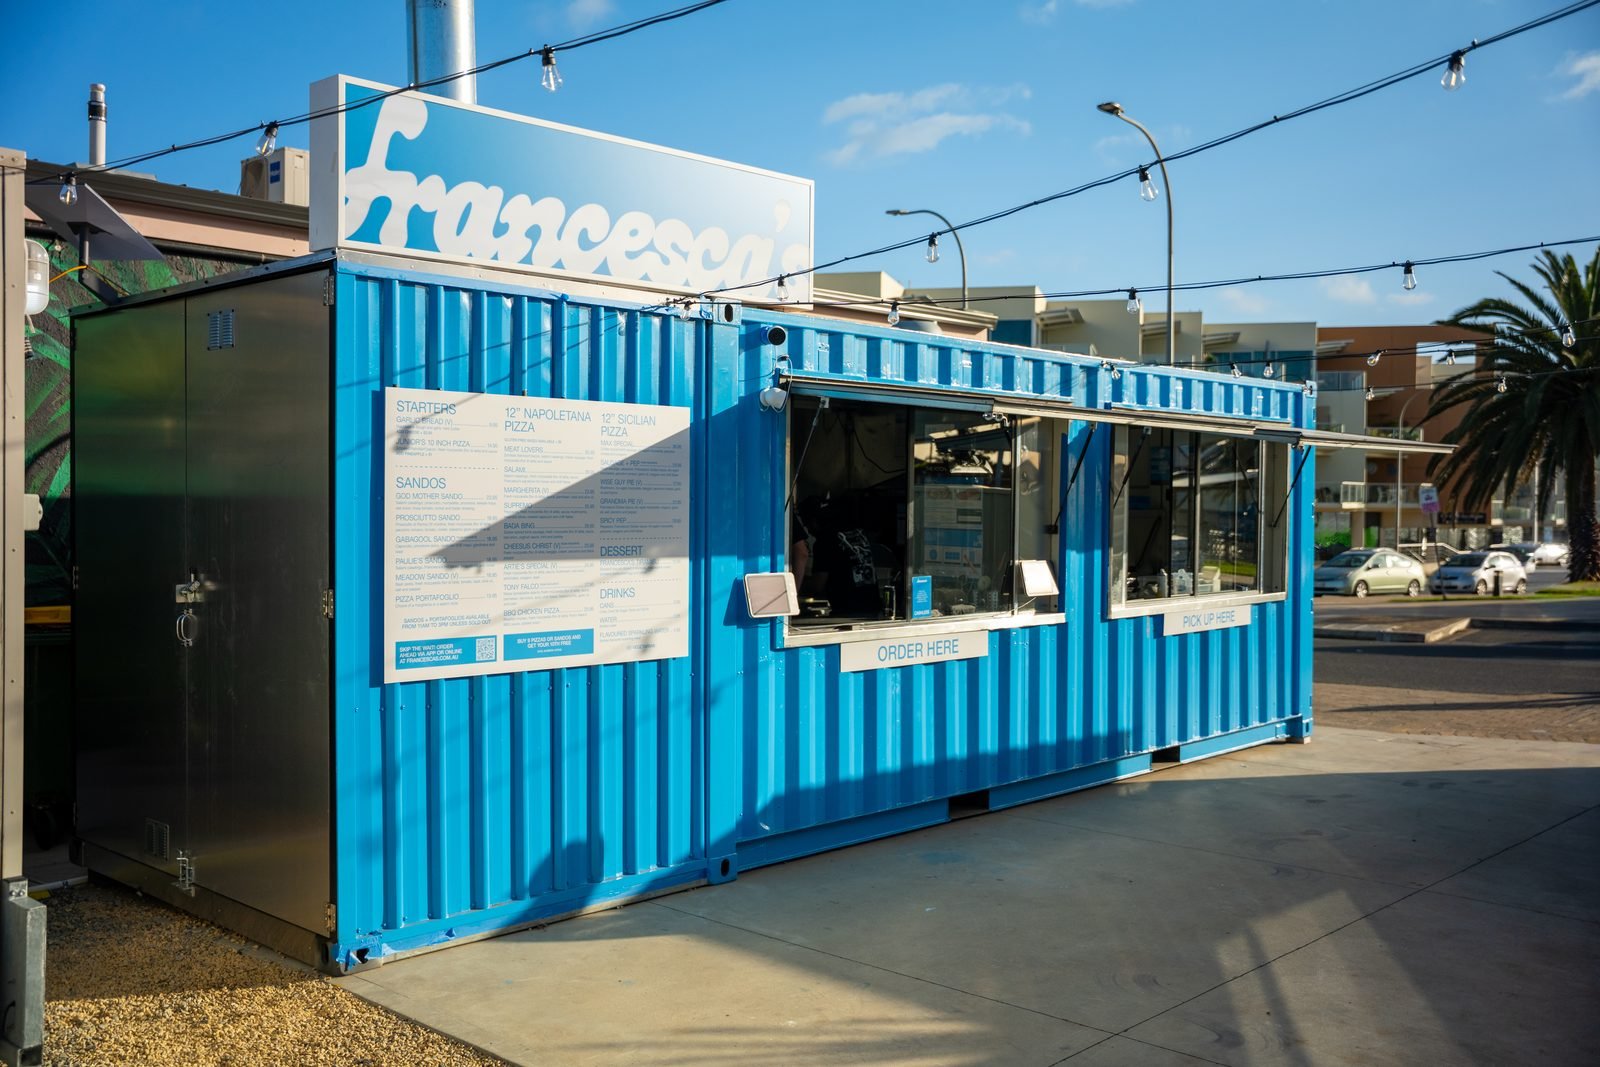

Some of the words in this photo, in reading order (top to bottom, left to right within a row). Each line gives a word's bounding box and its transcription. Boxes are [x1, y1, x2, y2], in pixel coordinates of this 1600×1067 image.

[396, 400, 457, 415] STARTERS
[524, 408, 592, 422] NAPOLETANA
[618, 414, 656, 426] SICILIAN
[504, 421, 536, 433] PIZZA
[601, 426, 628, 437] PIZZA
[436, 439, 452, 447] INCH
[453, 440, 471, 448] PIZZA
[395, 476, 447, 490] SANDOS
[395, 492, 411, 500] GOD
[412, 492, 440, 500] MOTHER
[395, 535, 432, 543] GABAGOOL
[433, 535, 456, 543] SANDO
[532, 542, 553, 550] CHRIST
[600, 545, 644, 557] DESSERT
[424, 556, 448, 564] SANDO
[526, 562, 550, 570] SPECIAL
[395, 573, 425, 581] MEADOW
[426, 572, 450, 580] SANDO
[395, 595, 414, 603] PIZZA
[415, 593, 460, 602] PORTAFOGLIO
[600, 587, 636, 599] DRINKS
[517, 608, 543, 616] CHICKEN
[1183, 614, 1203, 628] PICK
[1203, 612, 1215, 626] UP
[1216, 610, 1236, 624] HERE
[877, 642, 923, 662] ORDER
[927, 639, 959, 657] HERE
